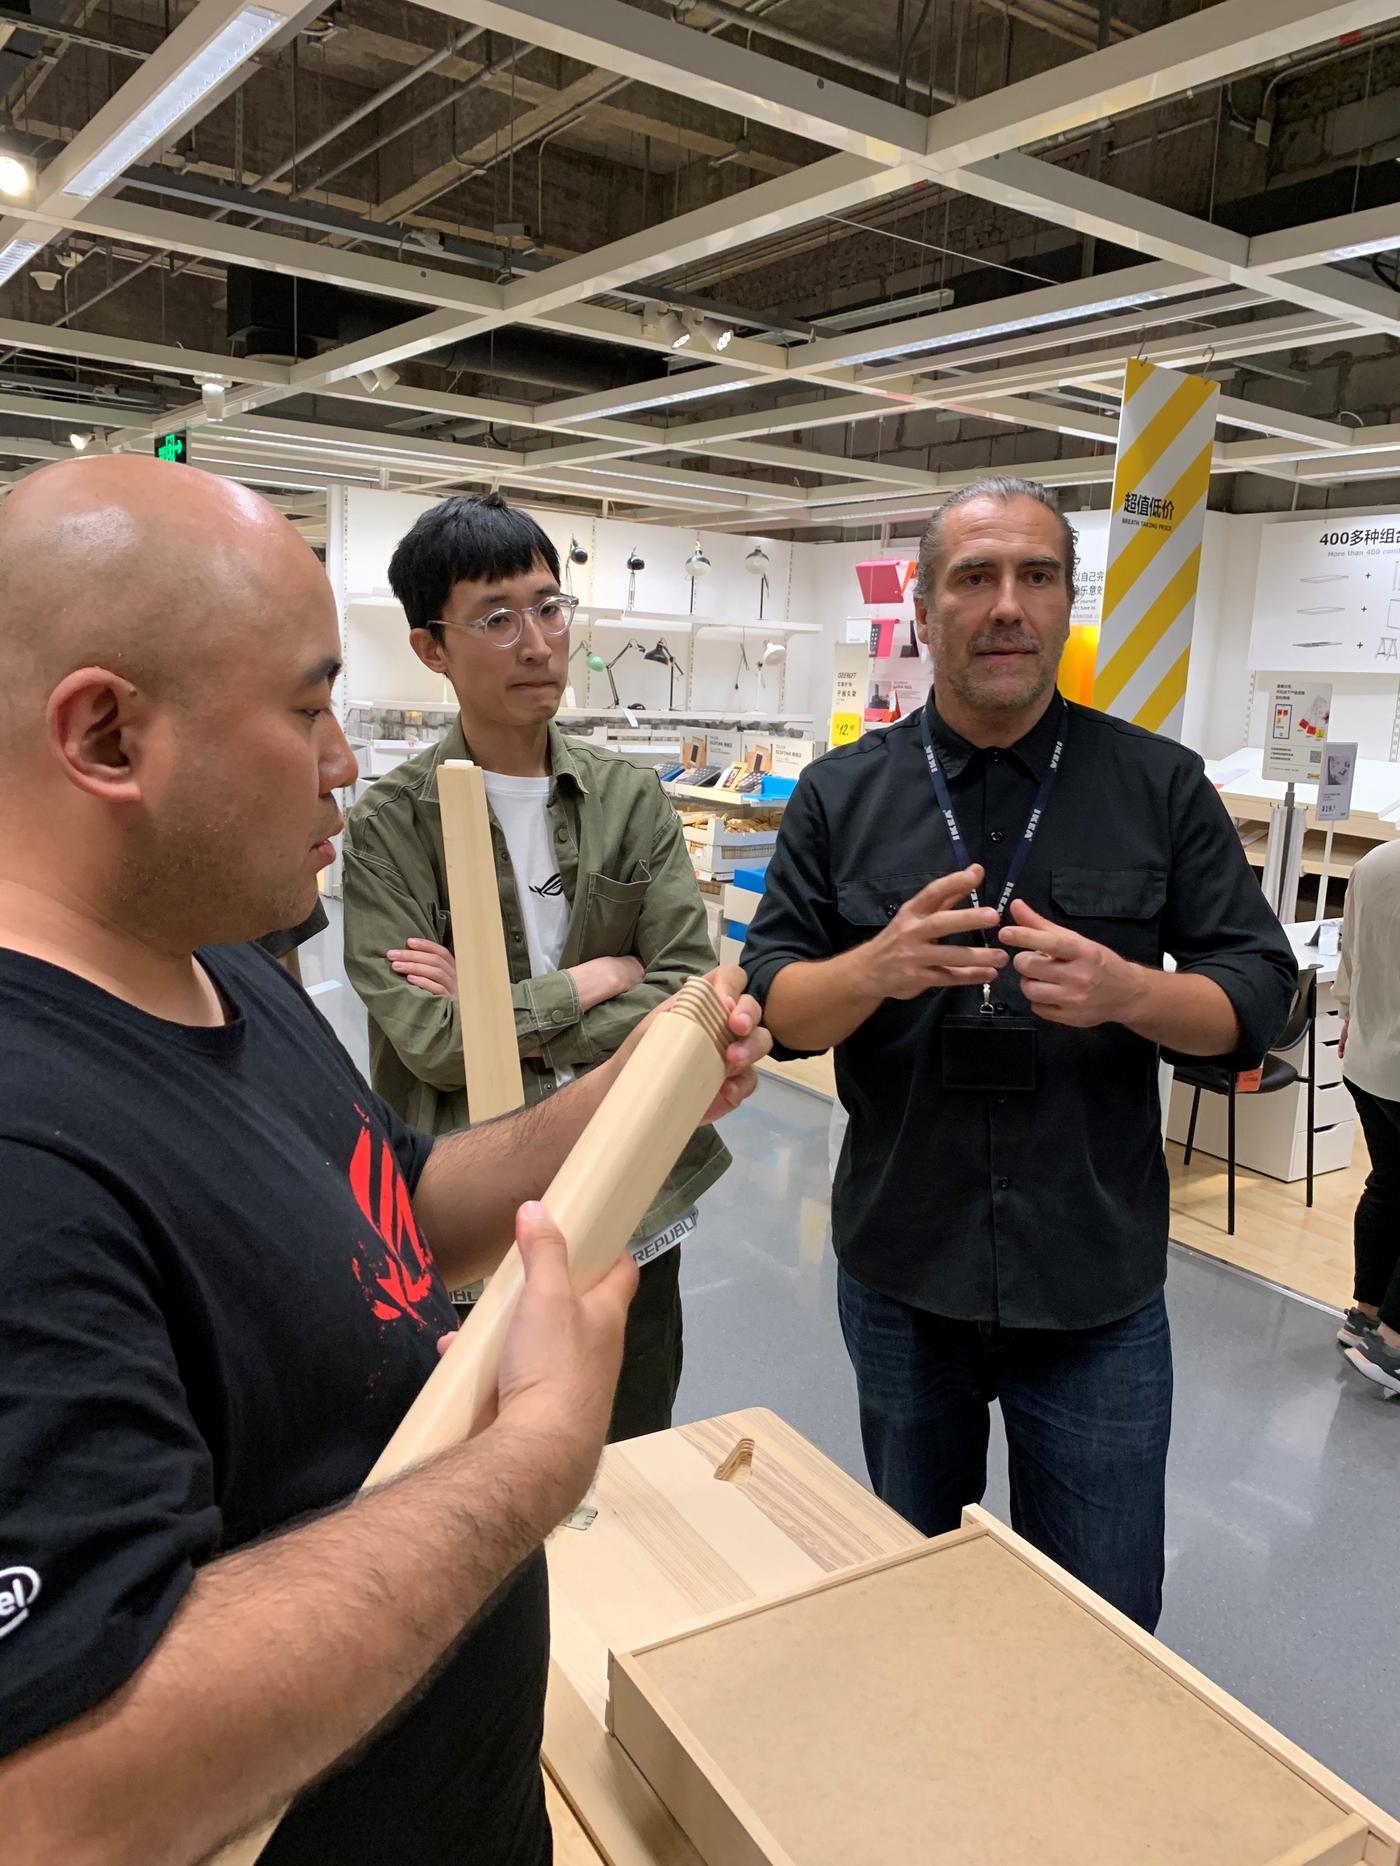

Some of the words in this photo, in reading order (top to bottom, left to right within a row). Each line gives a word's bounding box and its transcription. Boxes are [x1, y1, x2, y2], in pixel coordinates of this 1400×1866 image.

[1123, 492, 1174, 521] 超值低价
[924, 745, 938, 773] IKEA
[1050, 741, 1063, 769] IKEA
[945, 809, 961, 841] IKEA
[1023, 808, 1041, 840] IKEA
[996, 881, 1015, 913] IKEA
